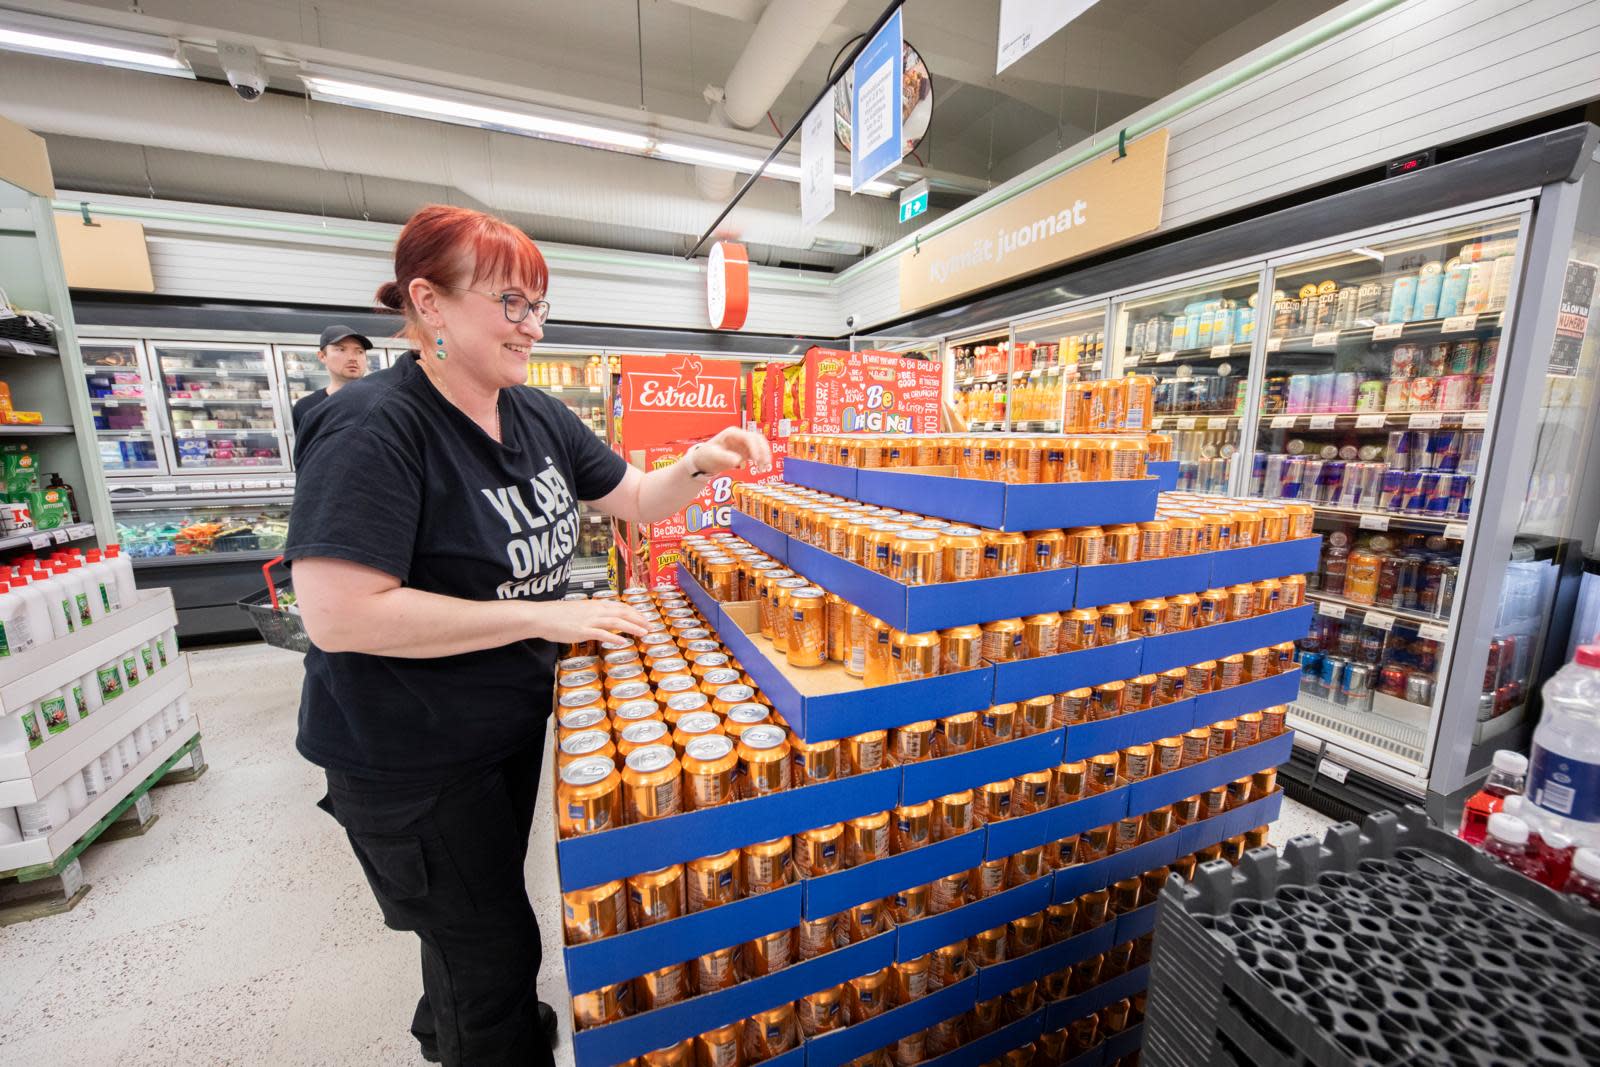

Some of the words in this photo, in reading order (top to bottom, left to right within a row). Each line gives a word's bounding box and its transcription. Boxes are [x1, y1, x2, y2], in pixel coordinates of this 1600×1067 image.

[928, 239, 993, 285] Kymät
[995, 199, 1087, 262] juomat
[640, 380, 727, 409] Estrella
[866, 385, 894, 409] Be
[507, 507, 580, 579] OMAST
